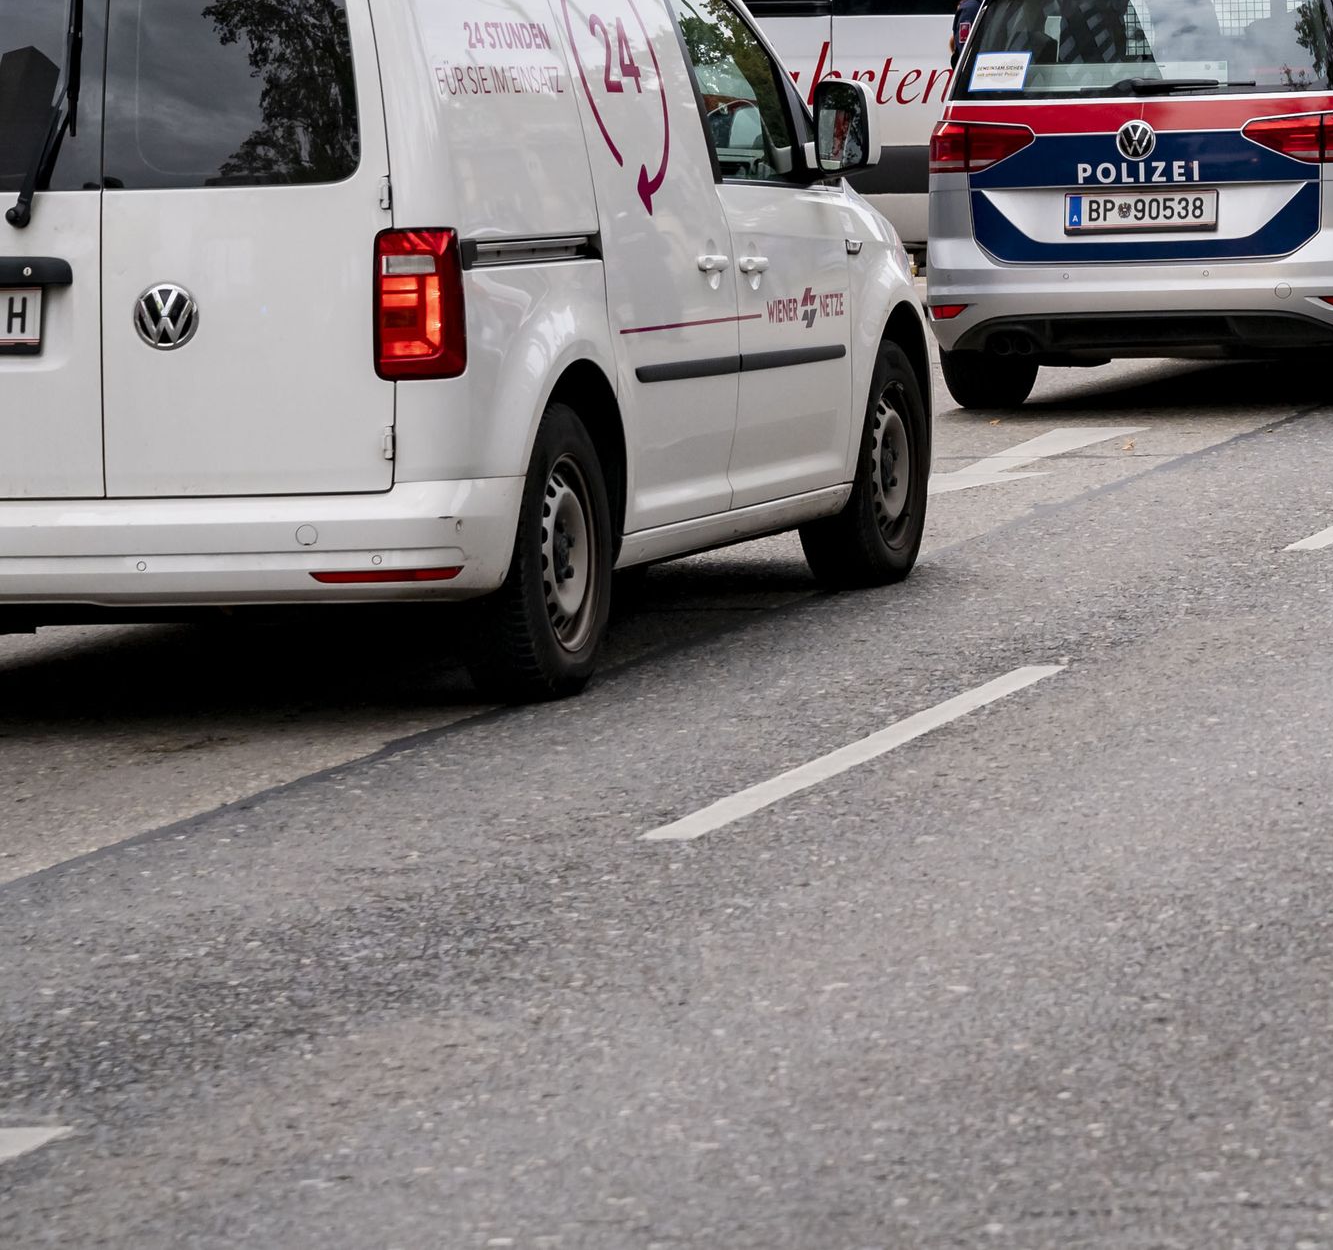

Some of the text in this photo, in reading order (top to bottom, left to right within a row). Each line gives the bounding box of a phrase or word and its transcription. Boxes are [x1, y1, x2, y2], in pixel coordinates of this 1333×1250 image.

[463, 21, 552, 50] 24 STUNDEN
[588, 13, 642, 94] 24
[435, 60, 564, 95] FÜR SIE IM EINSATZ
[1077, 160, 1200, 184] POLIZEI
[1088, 200, 1116, 223] BP
[1133, 197, 1205, 221] 90538
[767, 293, 844, 324] WIENER NETZE
